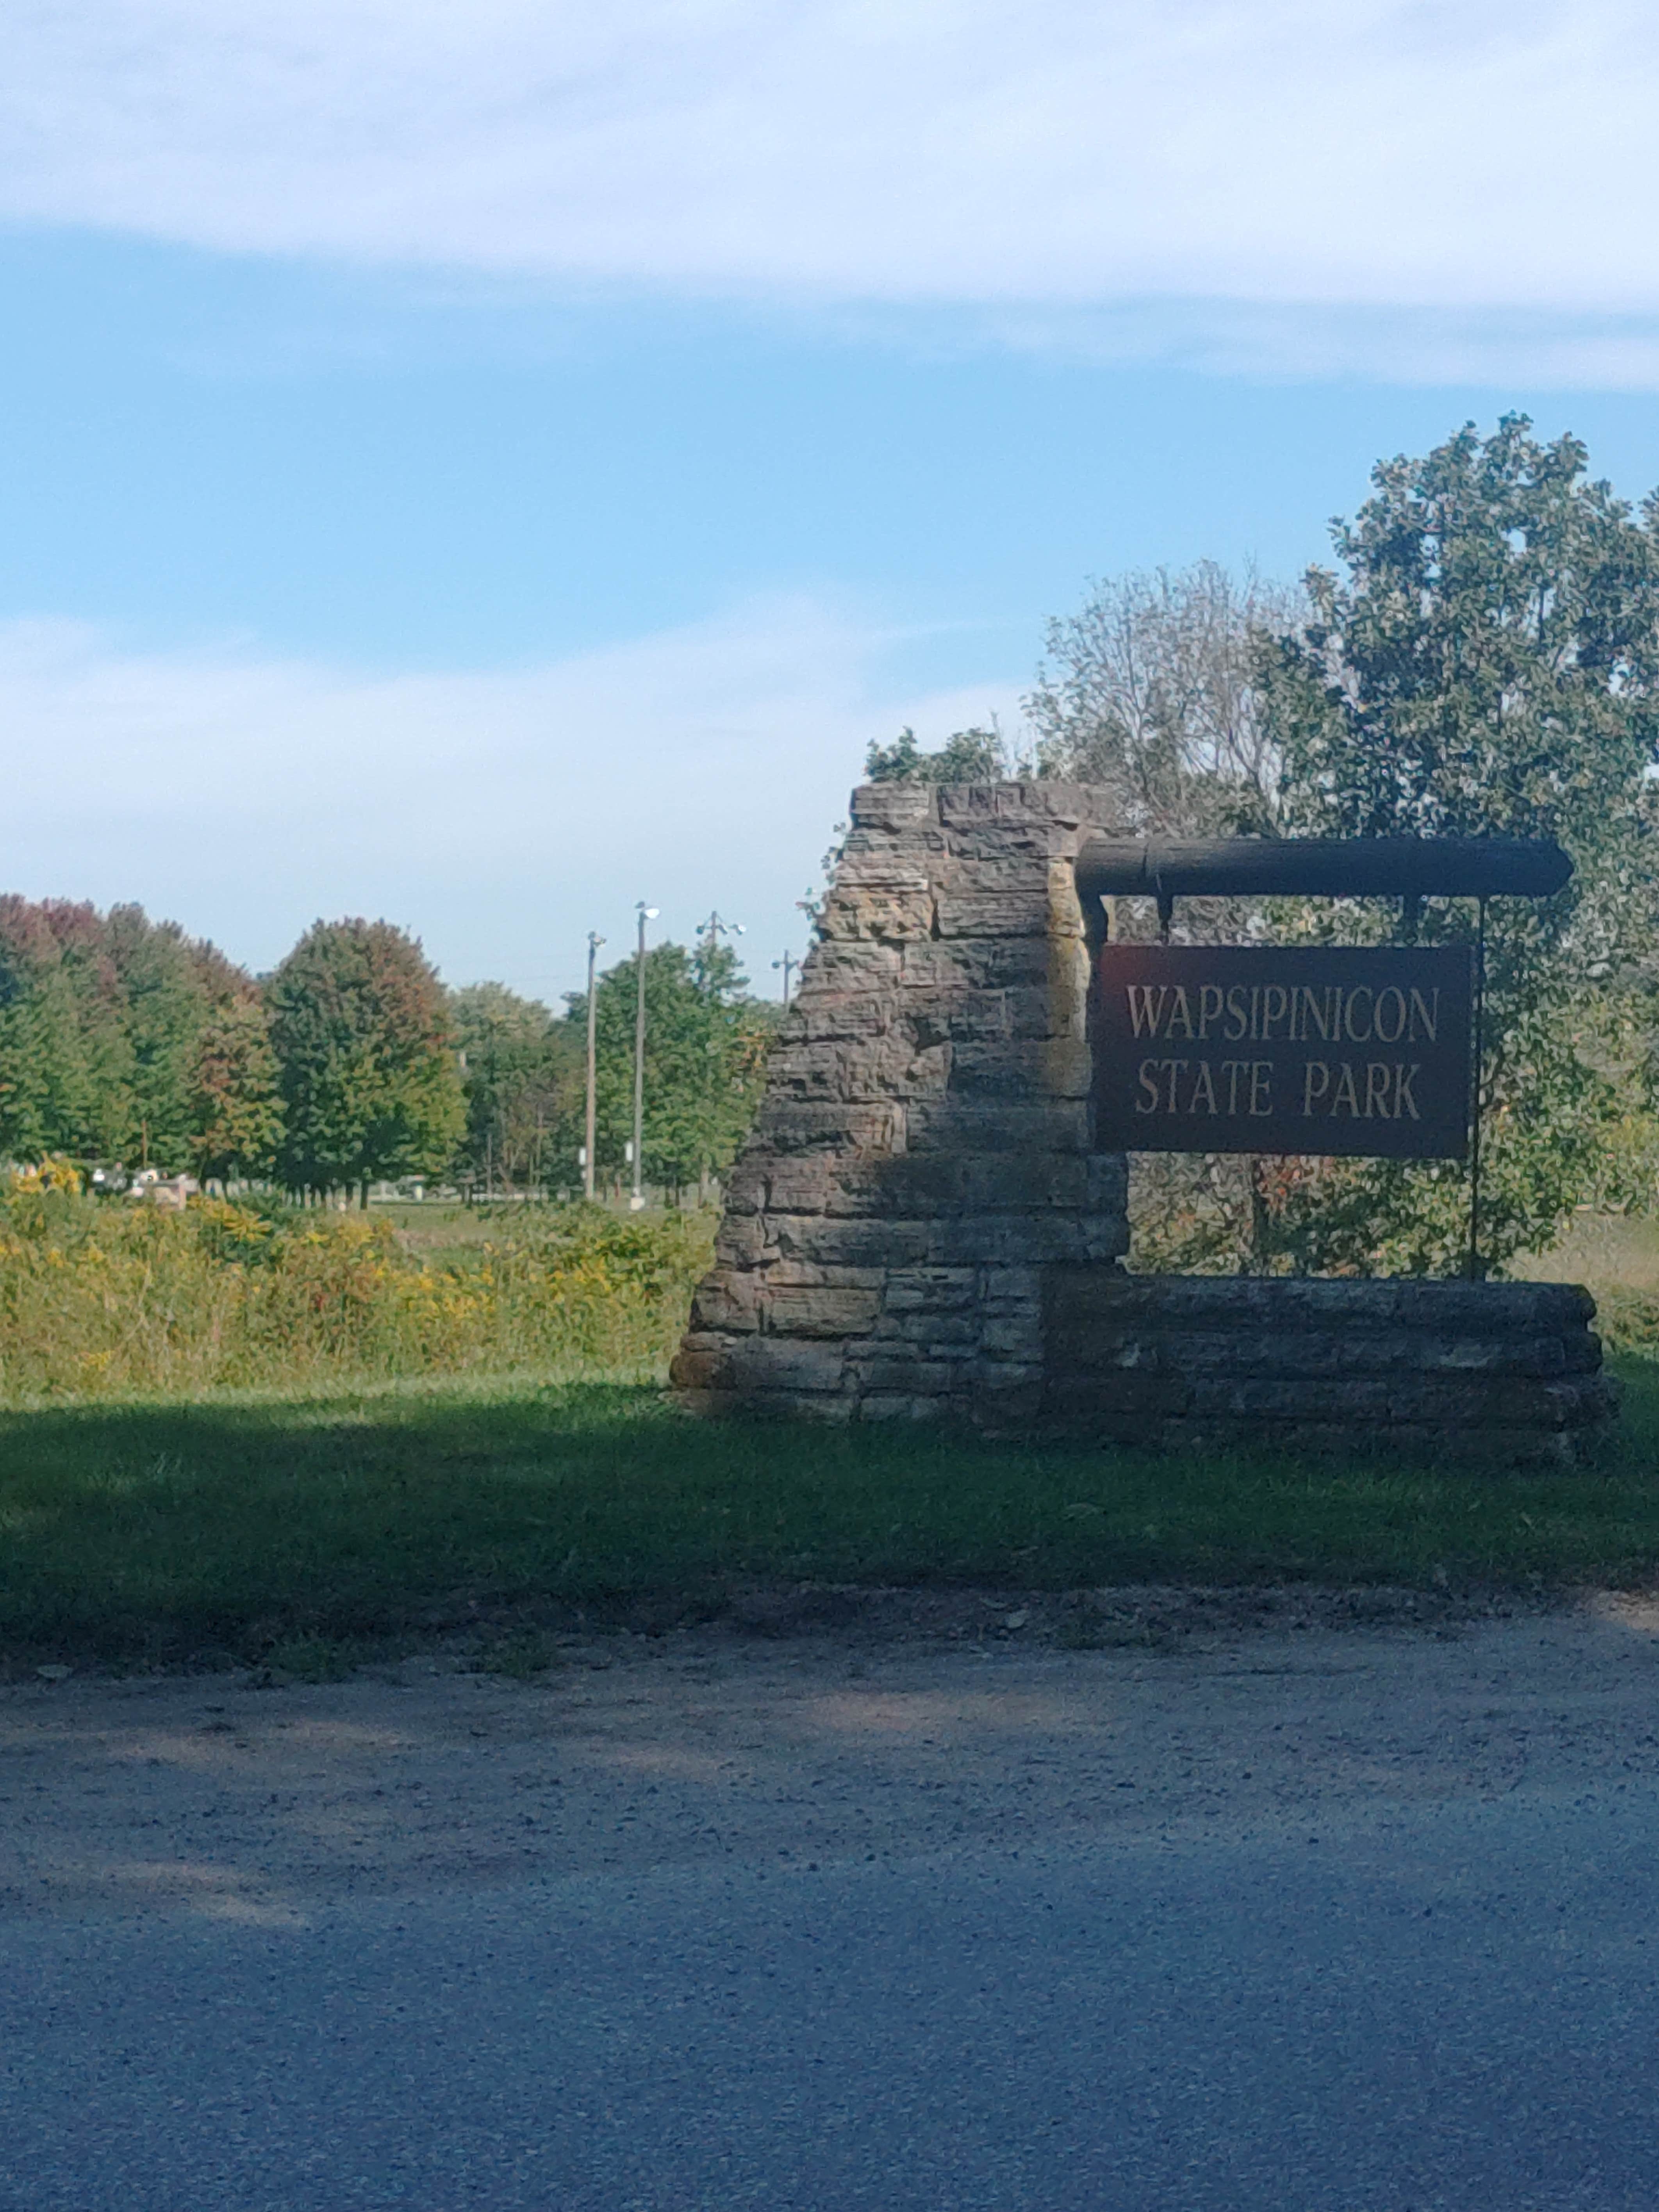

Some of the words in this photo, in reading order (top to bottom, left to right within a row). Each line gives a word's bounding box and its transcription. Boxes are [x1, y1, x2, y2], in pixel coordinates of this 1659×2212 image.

[1127, 984, 1439, 1042] WAPSIPINICON
[1135, 1058, 1274, 1116] STATE
[1301, 1061, 1421, 1120] PARK
